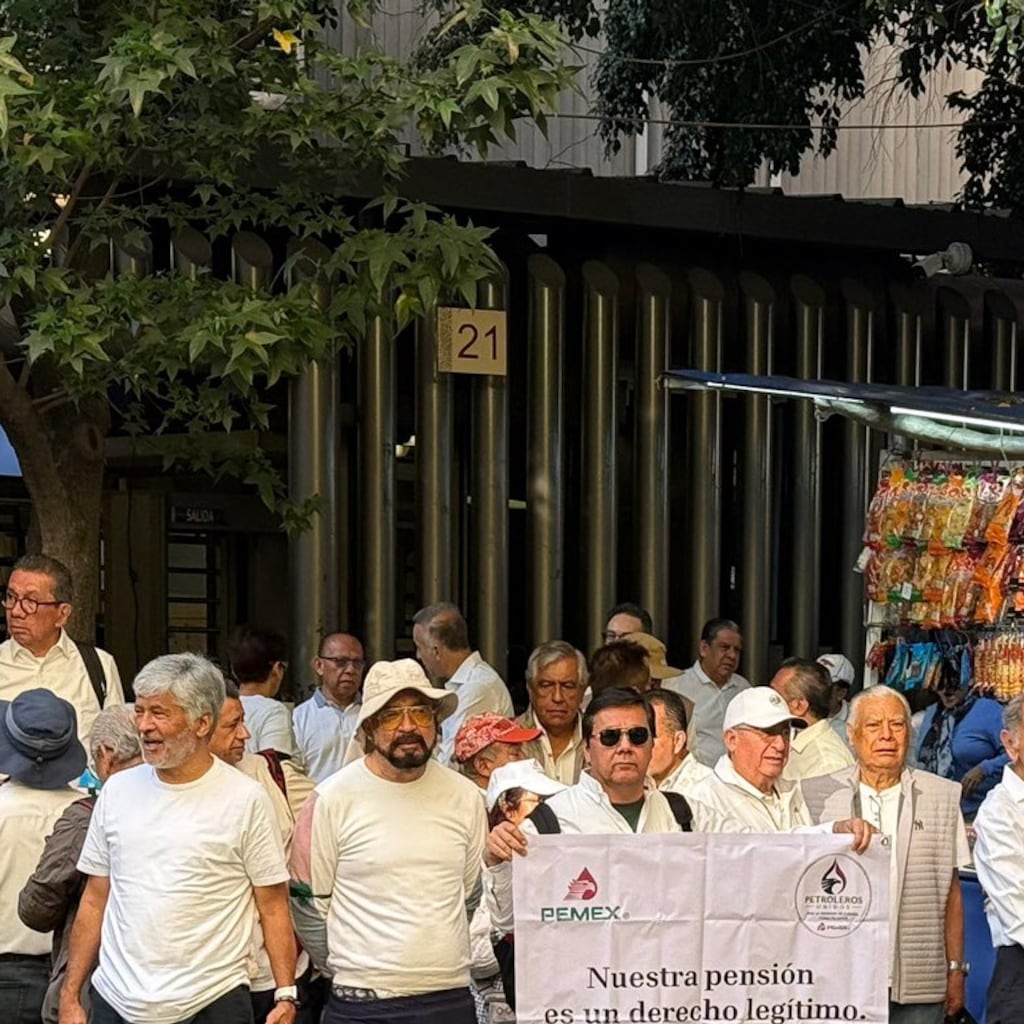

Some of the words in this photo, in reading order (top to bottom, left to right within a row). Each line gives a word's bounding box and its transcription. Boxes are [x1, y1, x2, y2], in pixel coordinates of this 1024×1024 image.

[458, 324, 497, 360] 21
[804, 895, 864, 904] PETROLEROS
[541, 906, 620, 922] PEMEX
[586, 966, 698, 989] Nuestra
[704, 963, 815, 991] pensión
[544, 1007, 574, 1024] es
[583, 1007, 621, 1024] un
[629, 999, 738, 1024] derecho
[747, 998, 867, 1024] legítimo.
